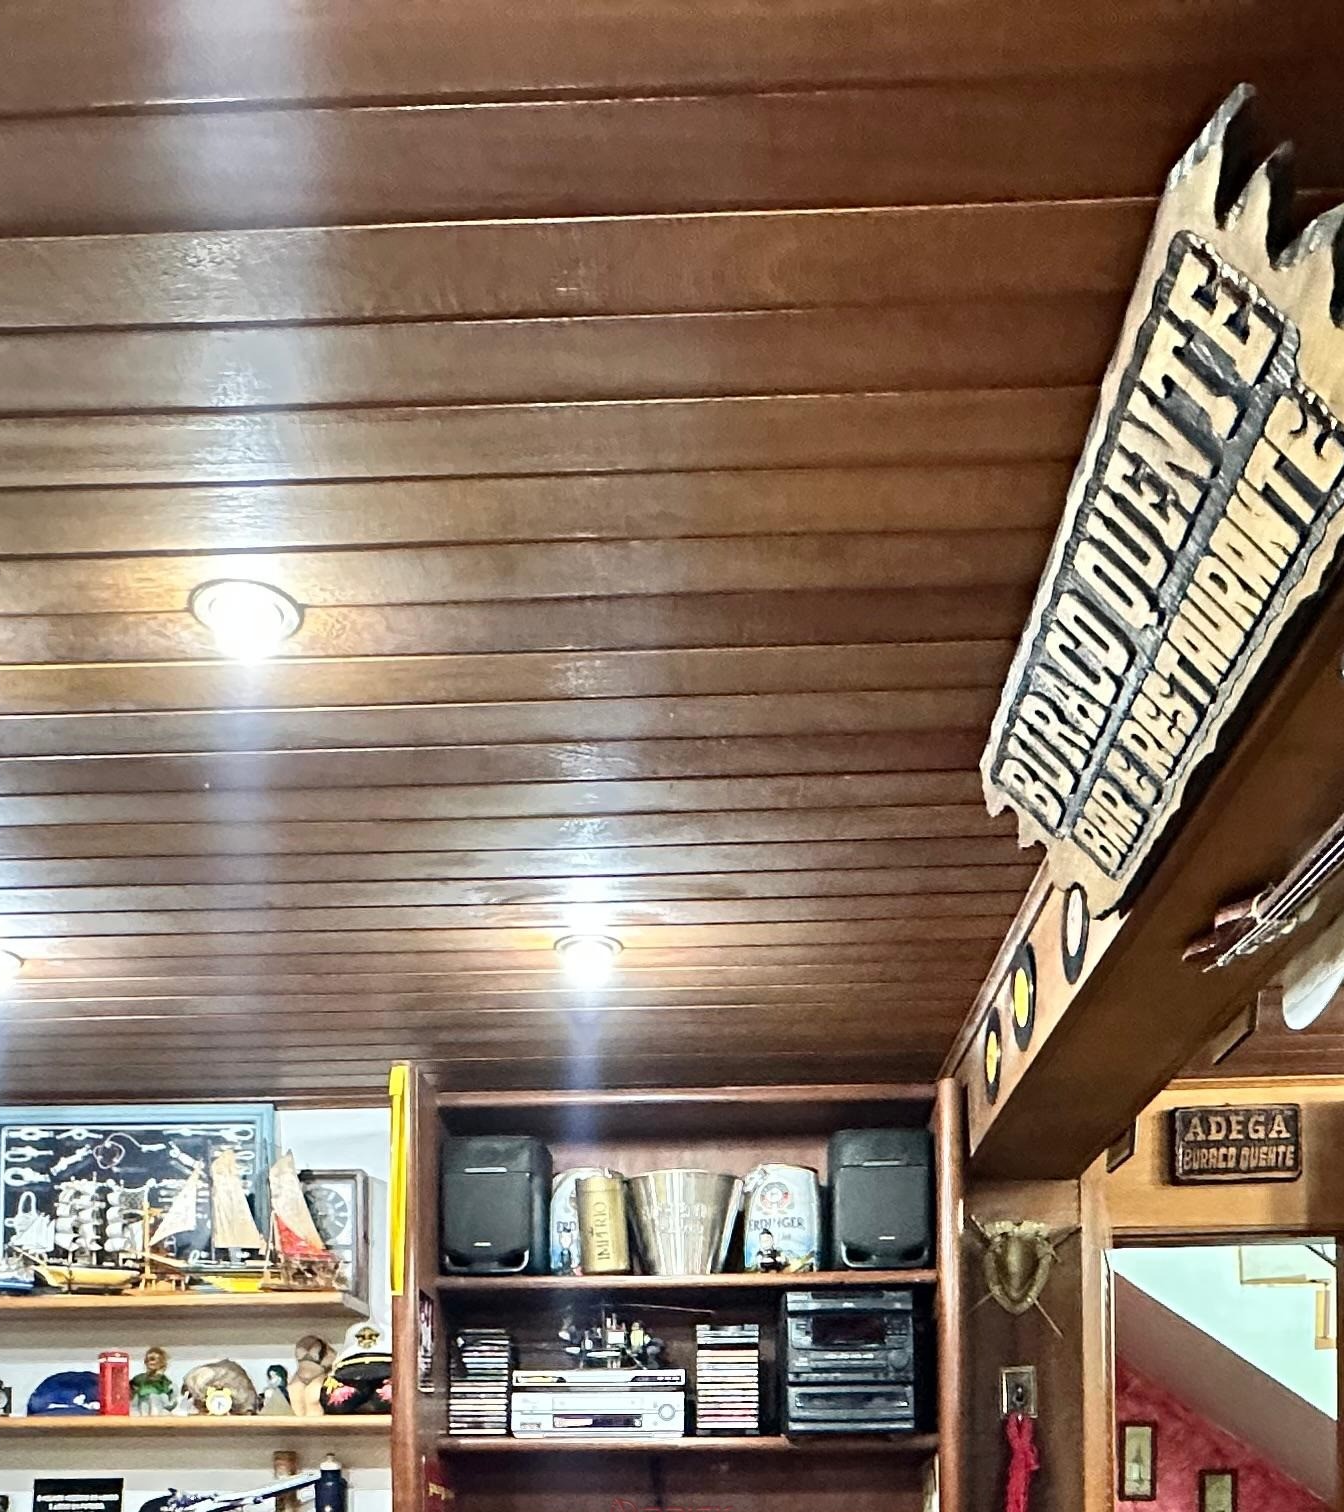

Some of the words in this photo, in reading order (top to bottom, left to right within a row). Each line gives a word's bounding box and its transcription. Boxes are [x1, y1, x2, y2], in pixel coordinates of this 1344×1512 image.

[999, 592, 1131, 828] BURACO
[1074, 252, 1277, 629] QUENTE
[1106, 747, 1160, 804] E
[1073, 777, 1146, 872] BAR
[1183, 1115, 1291, 1141] ADEGA
[1183, 1146, 1237, 1170] BURACO
